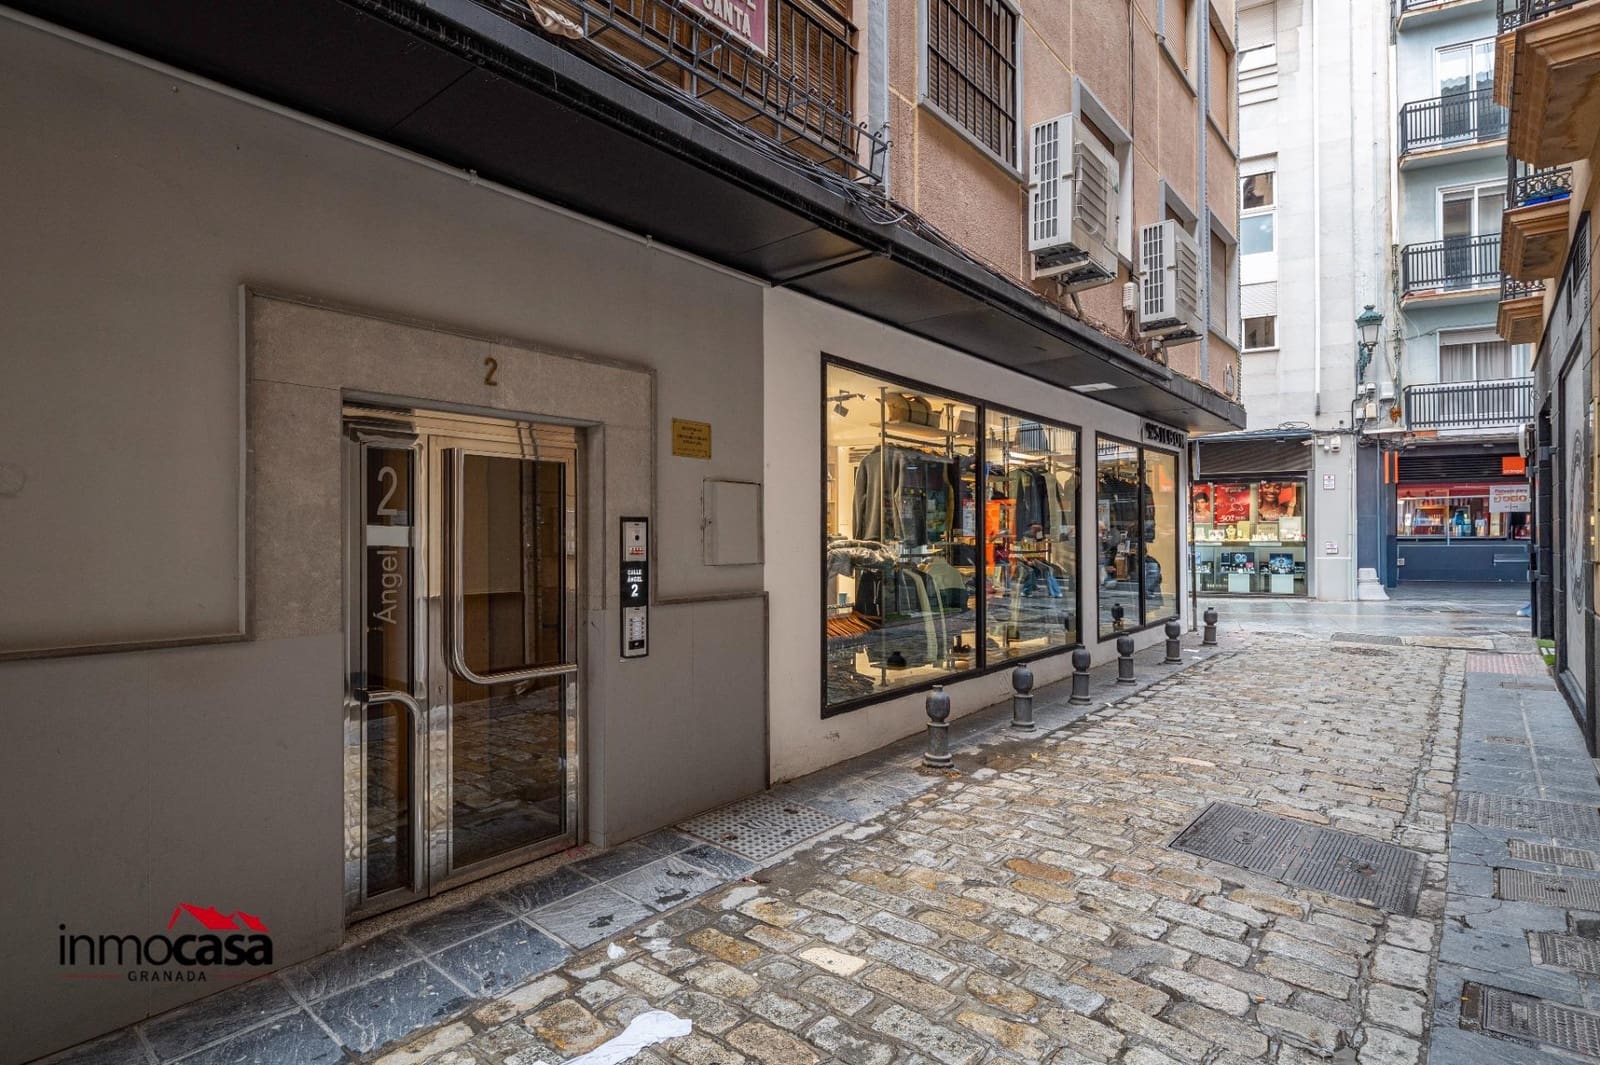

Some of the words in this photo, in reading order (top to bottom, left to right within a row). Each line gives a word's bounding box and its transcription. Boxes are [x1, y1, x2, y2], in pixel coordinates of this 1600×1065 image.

[484, 357, 498, 386] 2
[377, 466, 398, 516] 2
[373, 550, 403, 625] Ángel
[631, 583, 639, 597] 2
